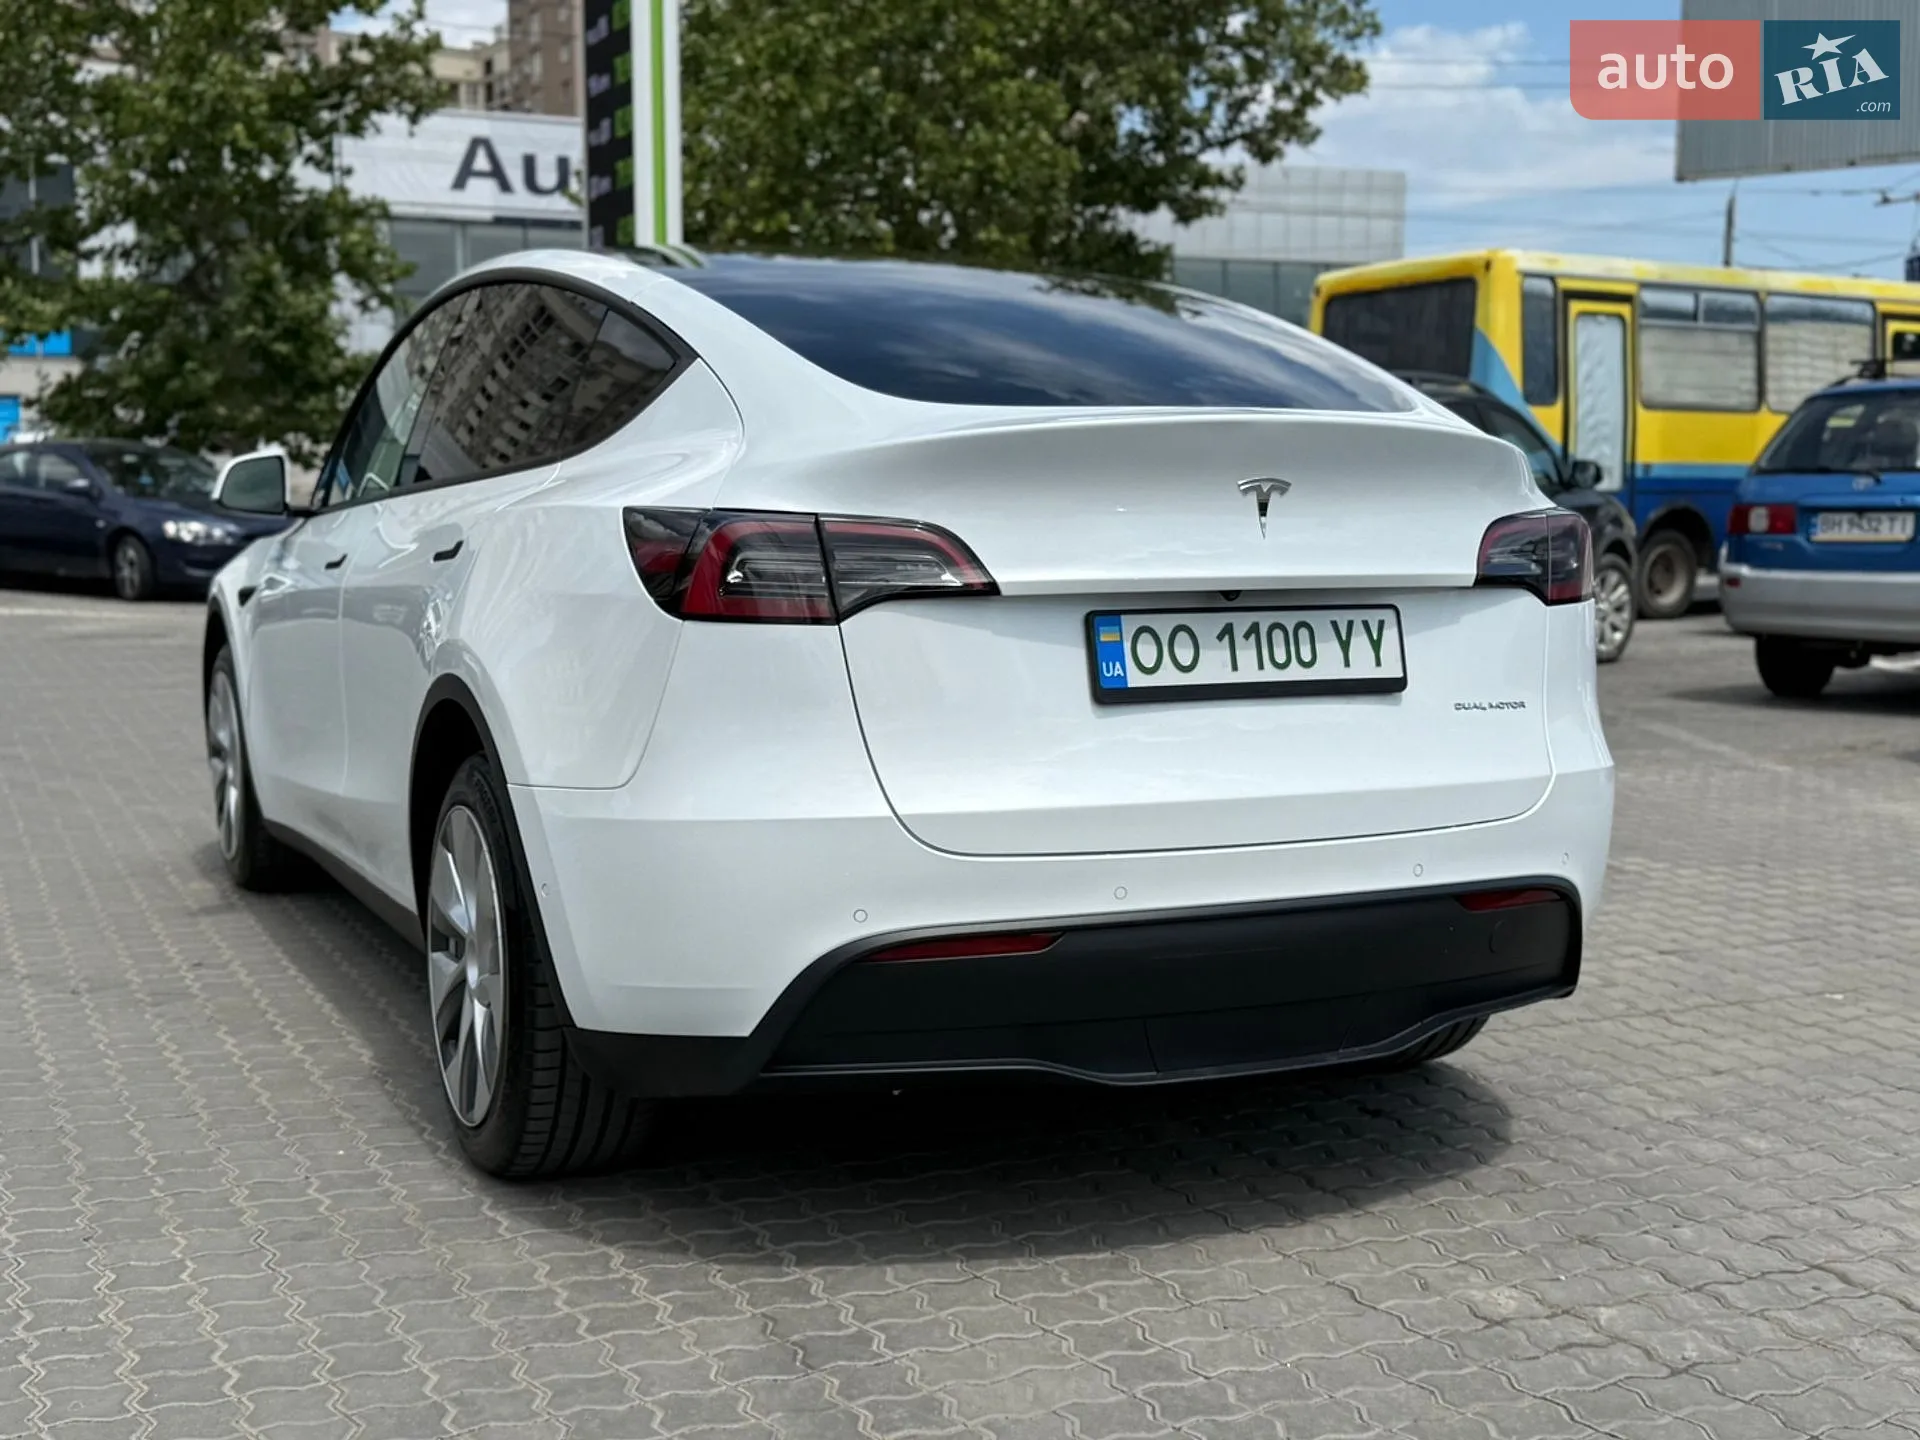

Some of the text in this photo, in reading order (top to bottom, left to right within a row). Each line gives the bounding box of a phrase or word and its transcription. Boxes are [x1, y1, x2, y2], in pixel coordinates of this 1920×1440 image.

[1216, 620, 1317, 672] 1100
[1330, 619, 1385, 668] YY
[1102, 661, 1124, 677] UA
[1454, 700, 1526, 711] DUAL MOTOR
